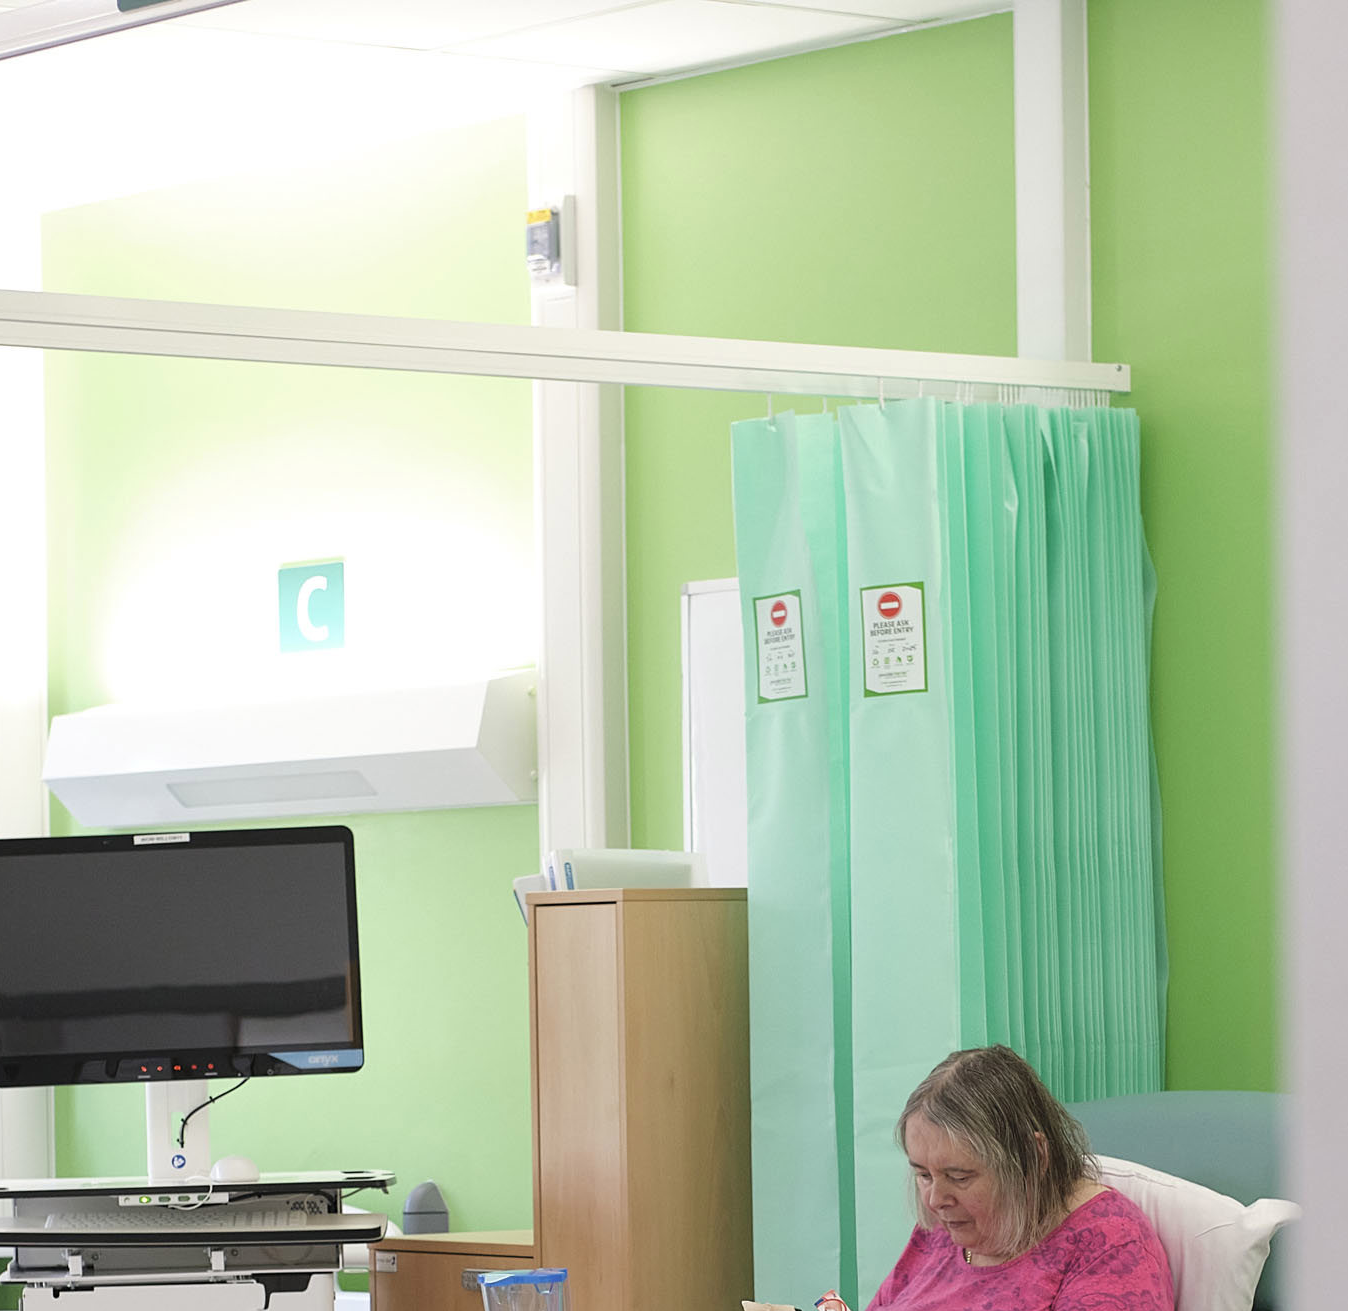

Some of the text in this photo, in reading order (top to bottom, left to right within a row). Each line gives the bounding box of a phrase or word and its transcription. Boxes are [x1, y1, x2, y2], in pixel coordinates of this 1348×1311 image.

[297, 575, 329, 642] C
[873, 621, 895, 629] PLEASE
[870, 626, 914, 637] BEFORE ENTRY
[308, 1055, 339, 1067] onyx
